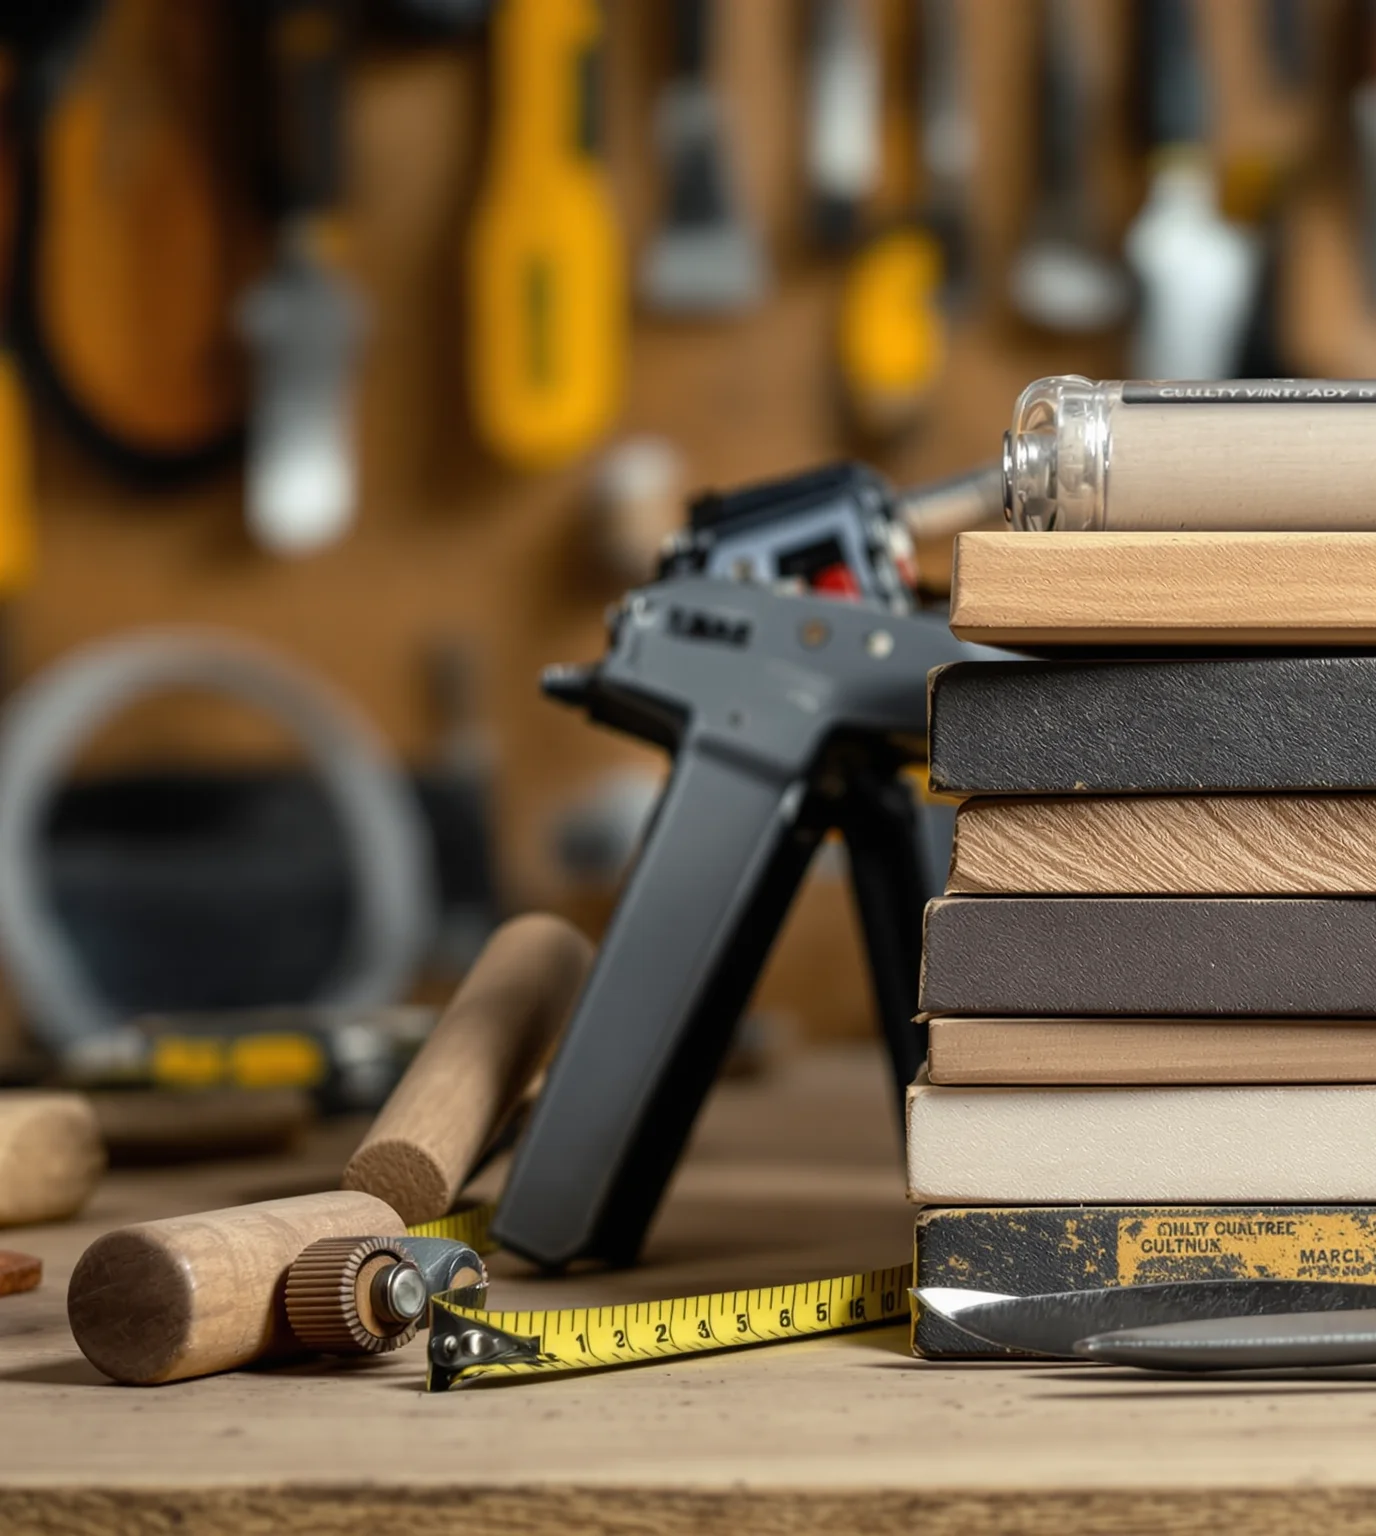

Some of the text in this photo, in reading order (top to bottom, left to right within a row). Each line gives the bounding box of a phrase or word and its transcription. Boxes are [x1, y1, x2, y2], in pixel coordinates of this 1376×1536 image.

[575, 1333, 586, 1353] 1
[613, 1329, 626, 1348] 2
[654, 1323, 669, 1343] 2
[697, 1319, 711, 1339] 3
[736, 1313, 748, 1333] 5
[779, 1308, 791, 1328] 6
[816, 1302, 828, 1322] 5
